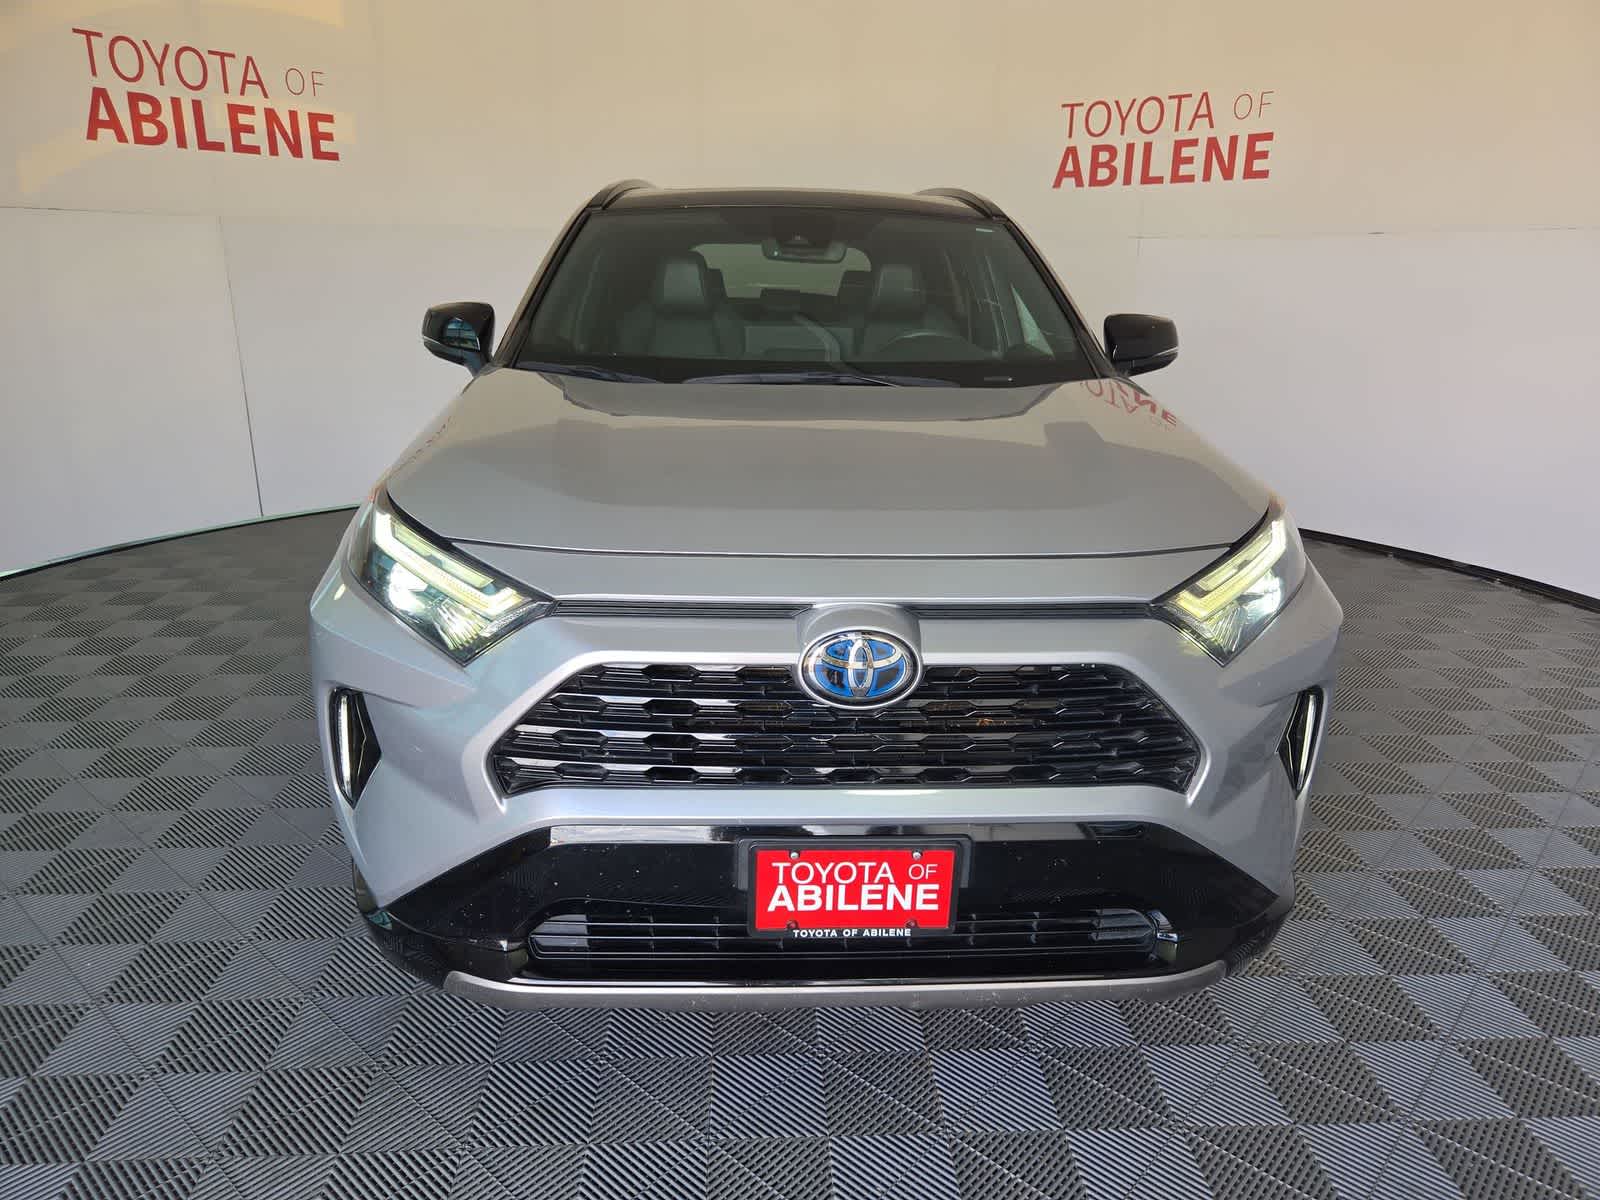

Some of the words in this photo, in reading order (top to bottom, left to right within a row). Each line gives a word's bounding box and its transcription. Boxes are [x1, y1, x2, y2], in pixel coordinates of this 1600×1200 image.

[72, 28, 269, 99] TOYOTA
[285, 67, 326, 97] OF
[86, 86, 340, 161] ABILENE
[1061, 91, 1215, 139] TOYOTA
[1233, 90, 1275, 120] OF
[1052, 131, 1274, 189] ABILENE
[771, 861, 894, 884] TOYOTA
[908, 863, 938, 880] OF
[767, 884, 940, 912] ABILENE
[792, 929, 838, 938] TOYOTA
[842, 928, 858, 937] OF
[862, 928, 912, 937] ABILENE
